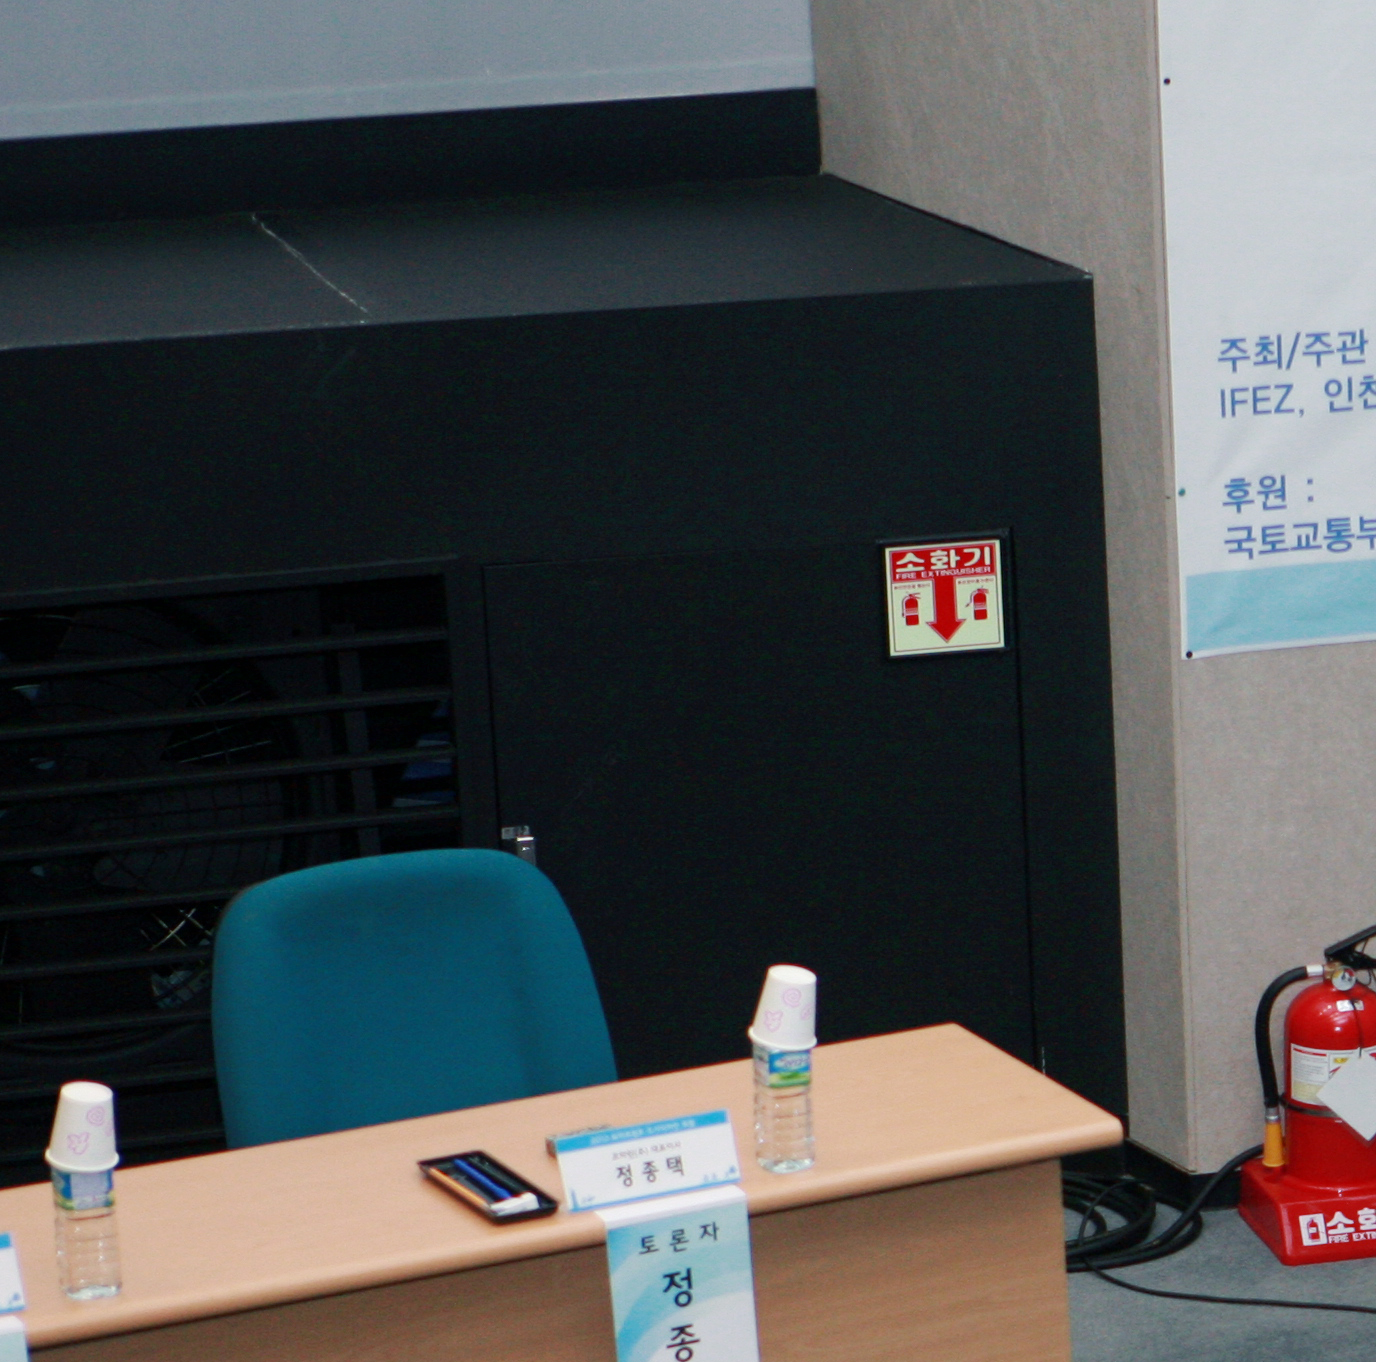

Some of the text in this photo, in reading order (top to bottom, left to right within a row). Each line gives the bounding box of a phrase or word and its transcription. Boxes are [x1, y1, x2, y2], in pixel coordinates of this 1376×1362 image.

[1217, 328, 1369, 373] 주최/주관
[1219, 383, 1305, 418] IFEZ,
[1222, 474, 1288, 514] 후원
[895, 546, 992, 573] 소화기
[895, 565, 992, 580] FIRE EXTINGUISHER
[1328, 1233, 1350, 1244] FIRE
